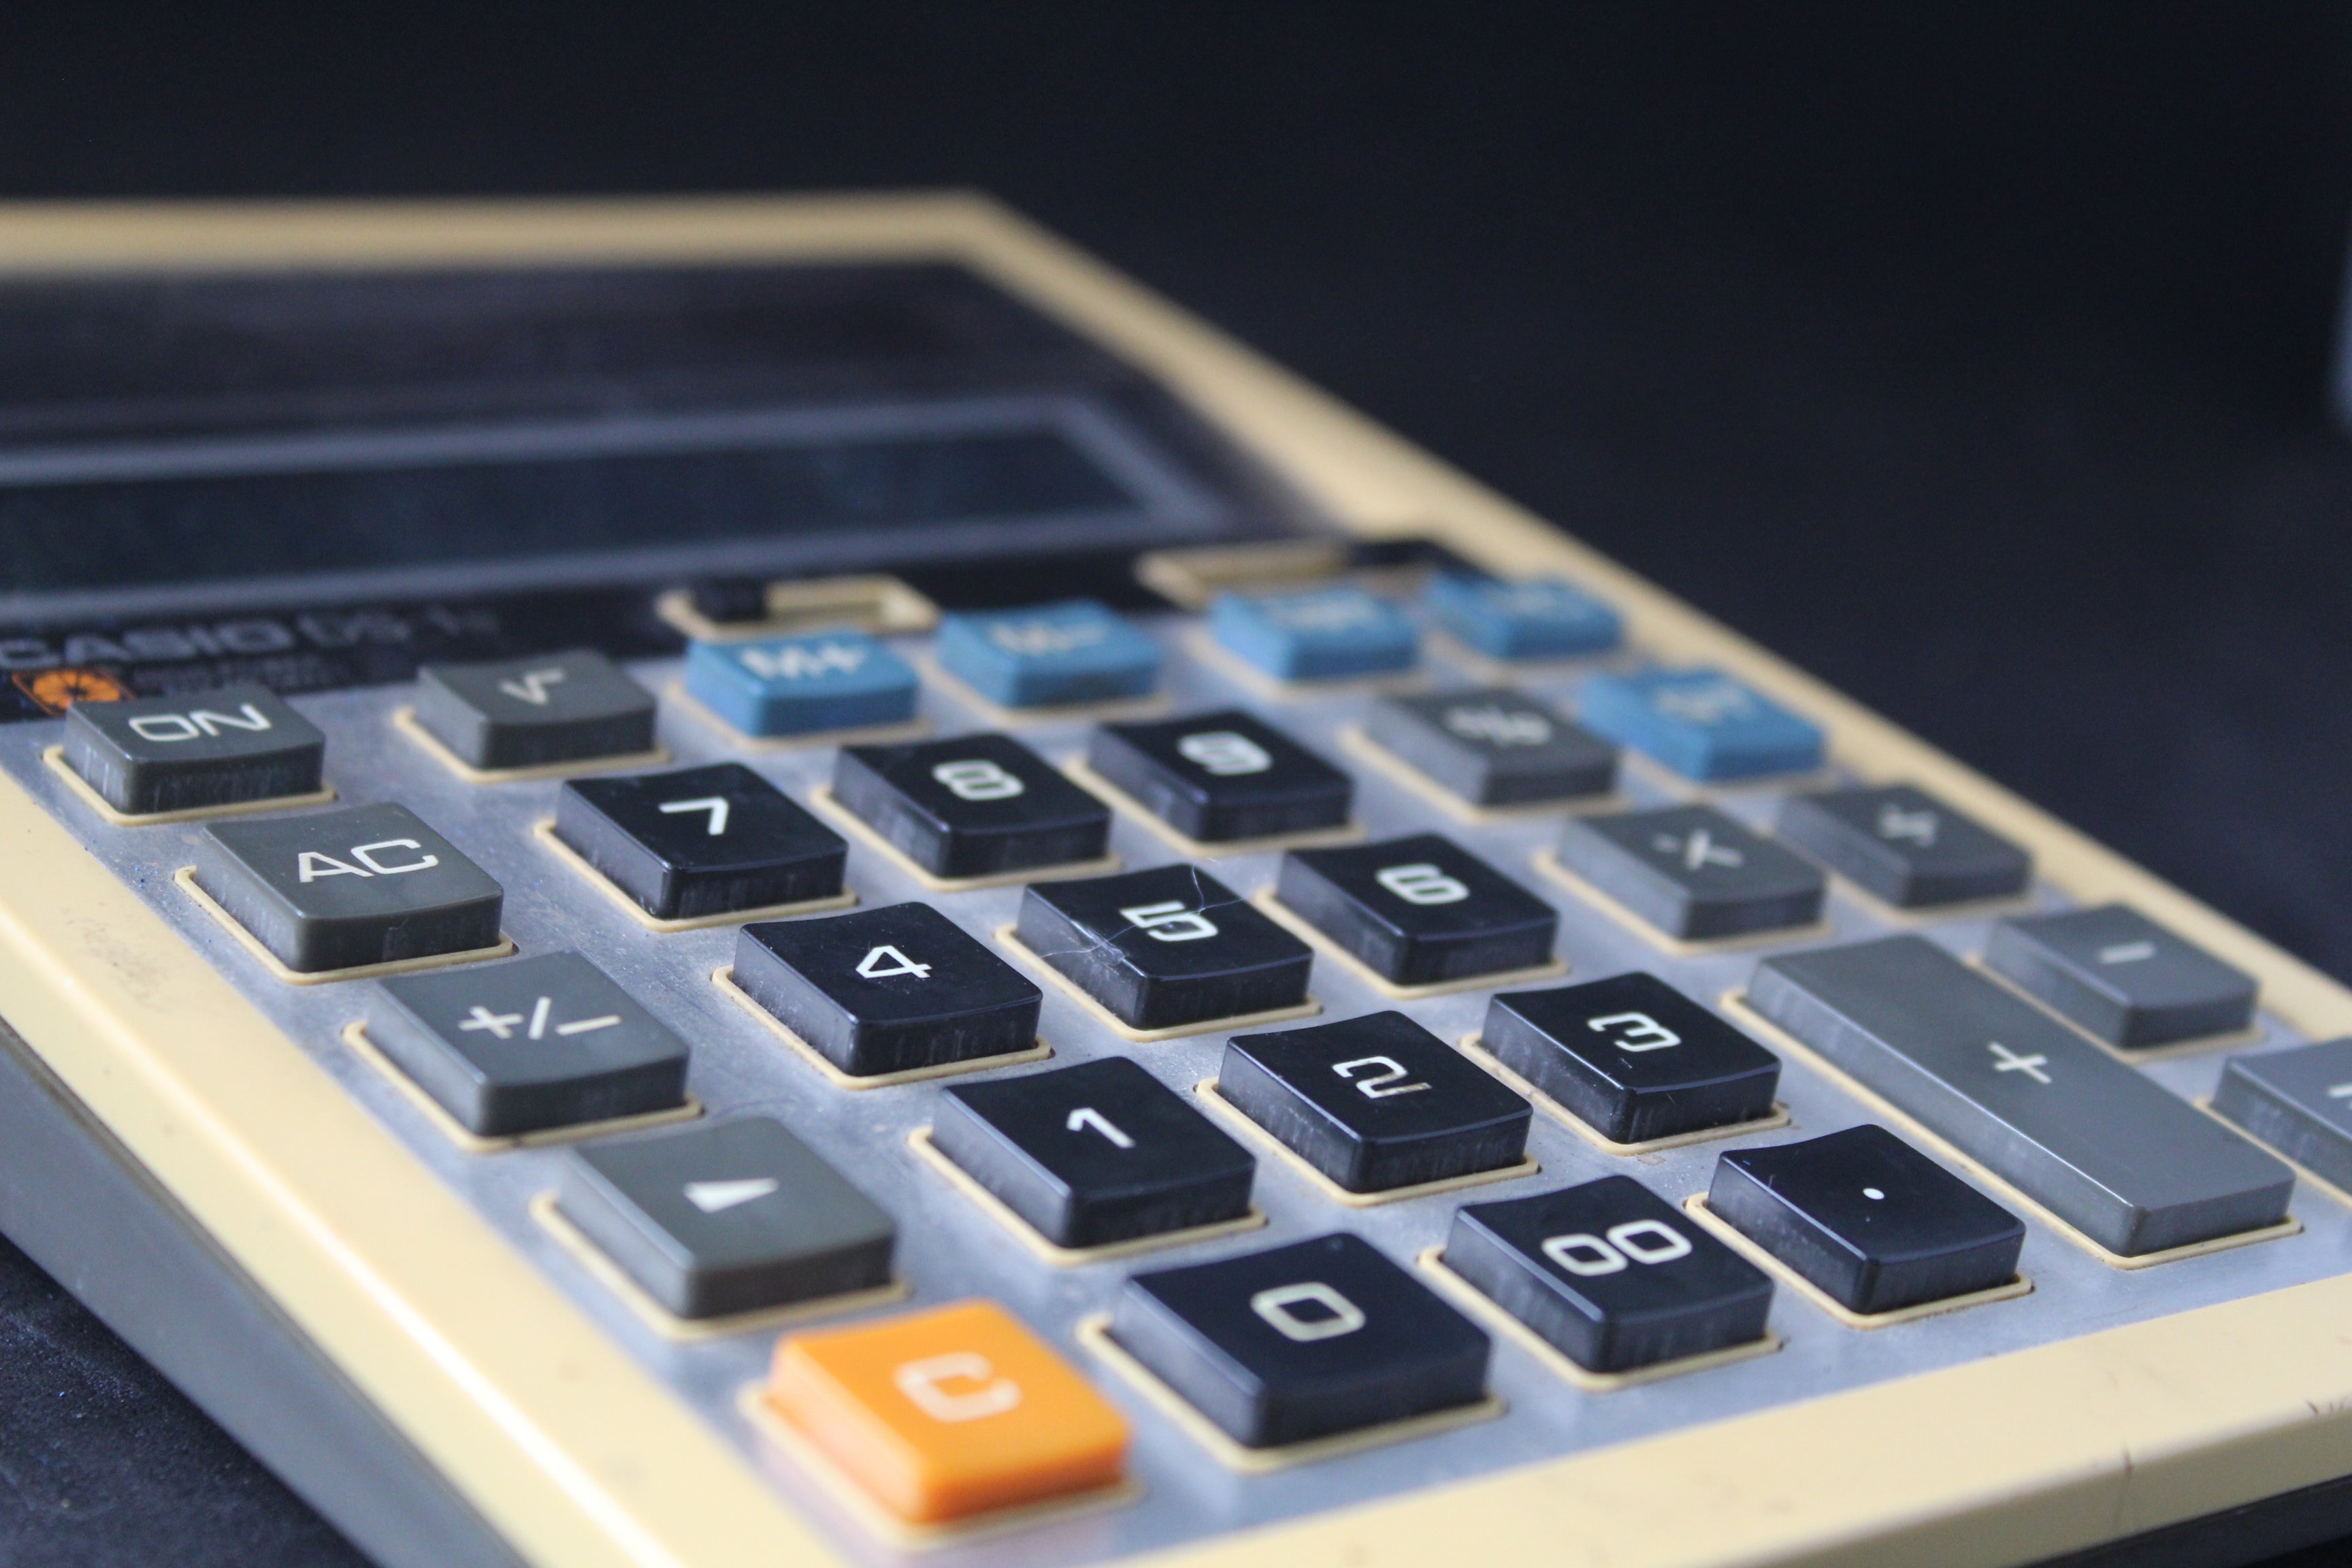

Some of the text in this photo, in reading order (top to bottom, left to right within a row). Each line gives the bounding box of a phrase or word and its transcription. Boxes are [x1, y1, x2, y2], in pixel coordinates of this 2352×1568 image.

[0, 616, 296, 670] CASIO
[129, 703, 271, 742] ON
[1179, 732, 1273, 776] 9
[932, 760, 1025, 801] 8
[658, 796, 730, 836] 7
[297, 838, 439, 883] AC
[1376, 864, 1469, 905] 6
[1121, 900, 1219, 942] 5
[855, 945, 932, 979] 4
[1588, 1012, 1681, 1052] 3
[1332, 1056, 1431, 1099] 2
[1066, 1107, 1134, 1149] 1
[1541, 1219, 1693, 1277] 00
[1250, 1281, 1366, 1342] 0
[894, 1350, 1022, 1424] C
